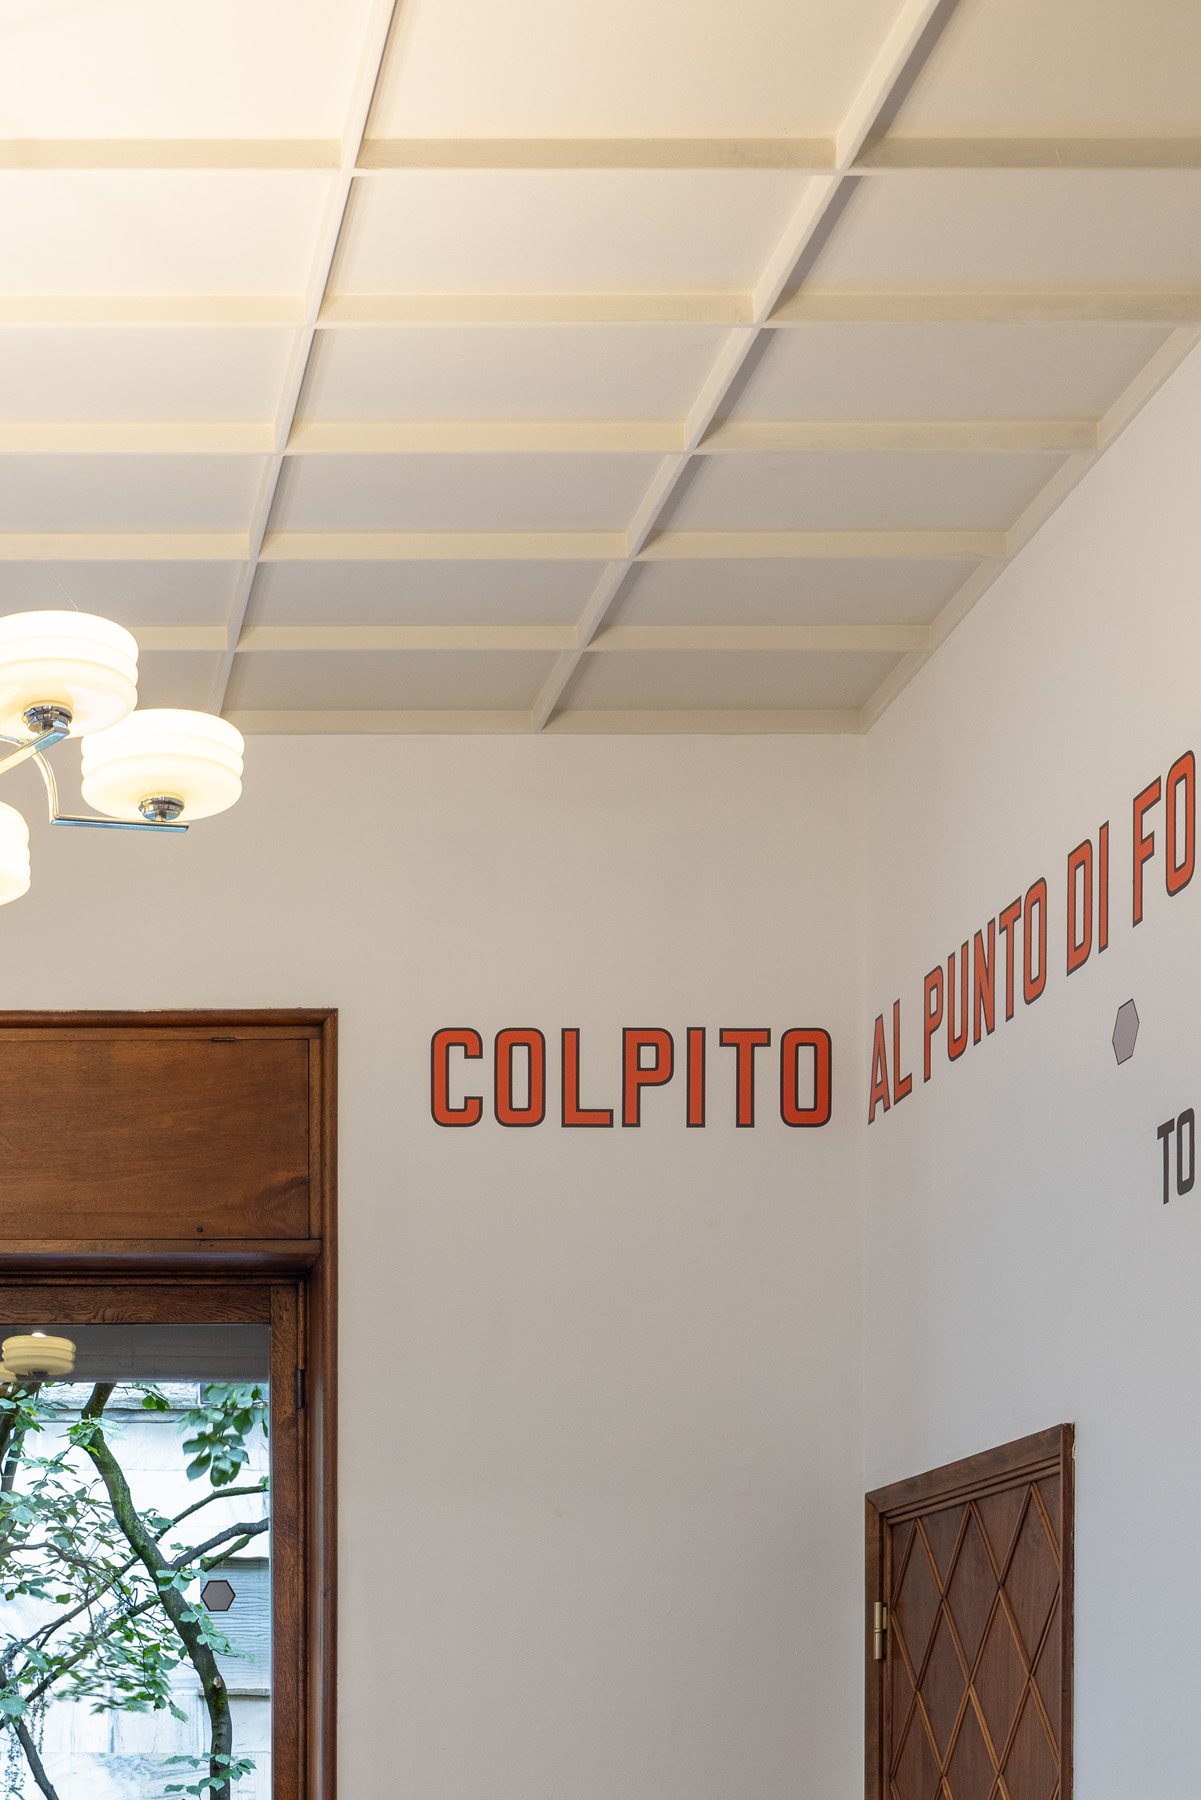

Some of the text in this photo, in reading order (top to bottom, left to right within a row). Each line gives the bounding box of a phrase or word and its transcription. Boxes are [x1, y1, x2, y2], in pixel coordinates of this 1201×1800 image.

[430, 1026, 833, 1129] COLPITO
[867, 998, 913, 1126] AL
[923, 877, 1048, 1084] PUNTO
[1065, 820, 1110, 977] DI
[1156, 1107, 1196, 1205] TO
